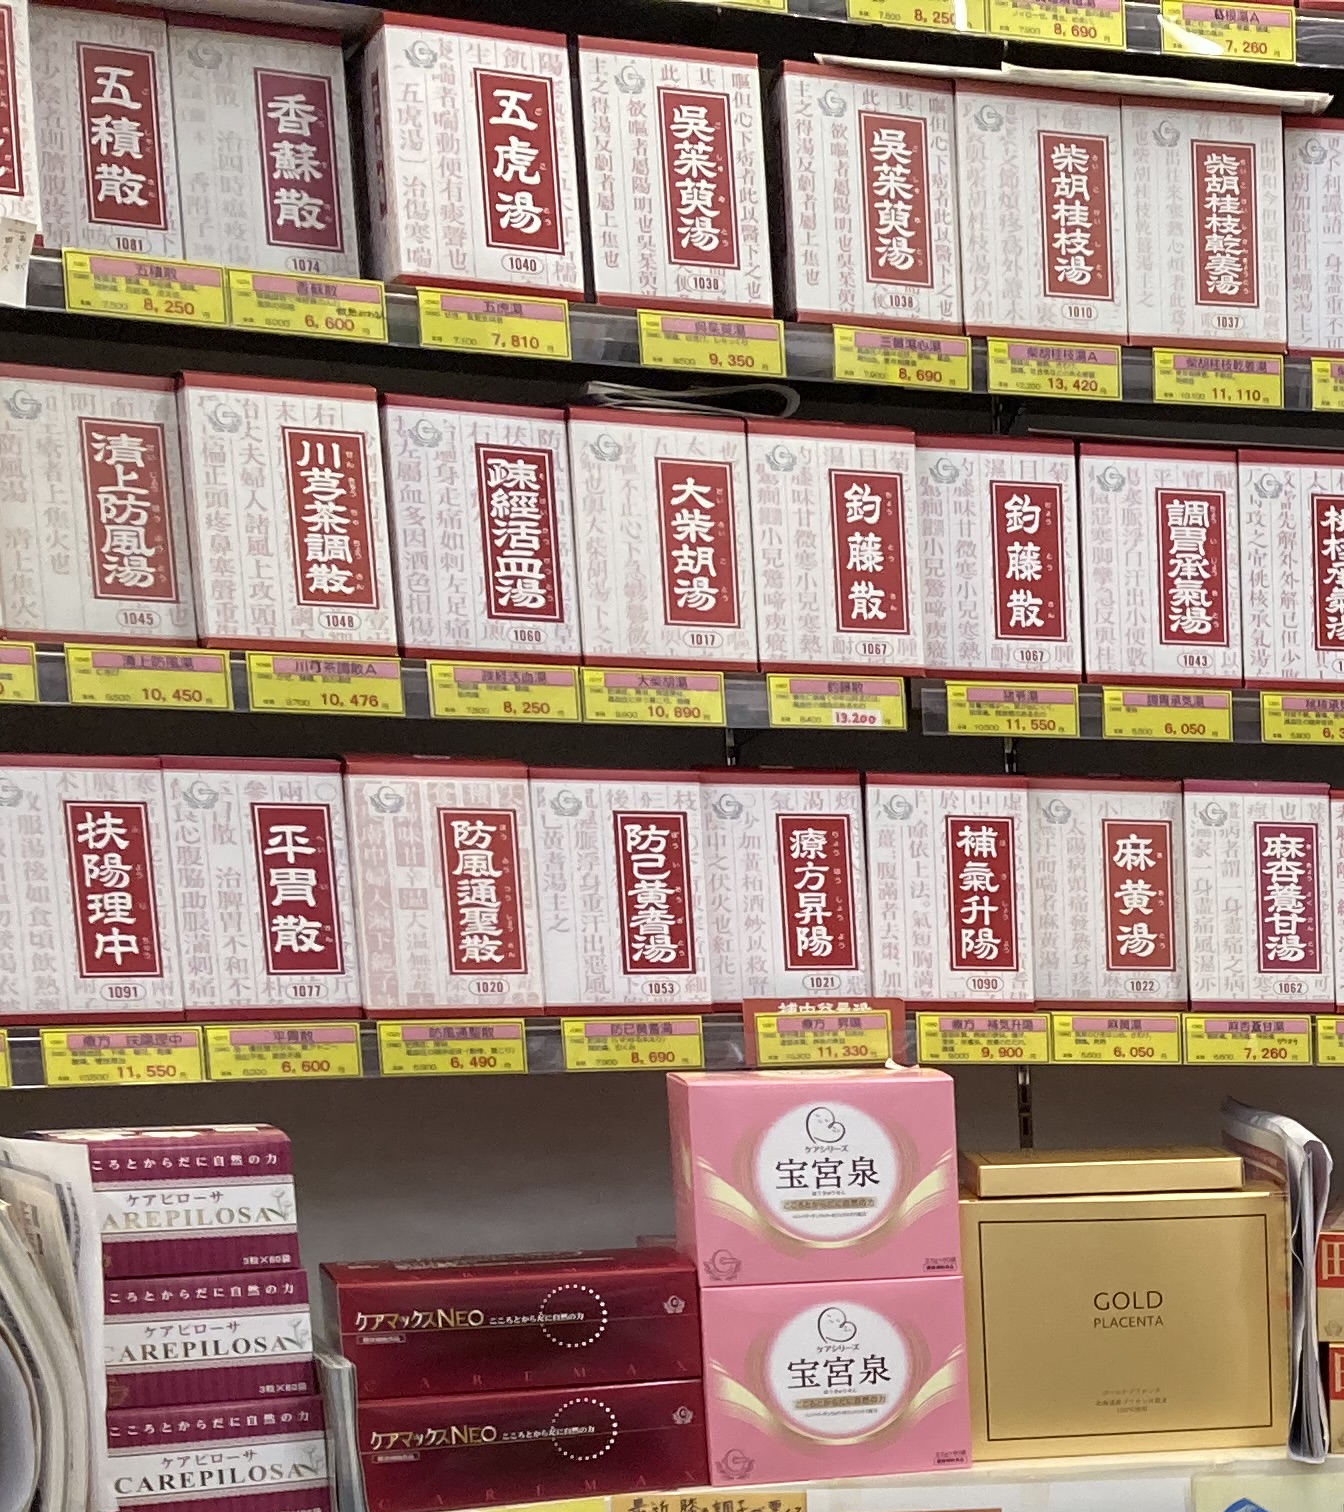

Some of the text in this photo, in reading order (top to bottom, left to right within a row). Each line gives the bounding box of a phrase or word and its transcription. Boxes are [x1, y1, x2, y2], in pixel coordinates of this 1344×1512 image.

[114, 238, 144, 251] 1081
[509, 256, 536, 272] 1040
[1216, 316, 1240, 329] 1037
[326, 614, 354, 628] 1048
[1184, 655, 1208, 668] 1043
[648, 982, 676, 995] 1053
[973, 978, 998, 990] 1090
[1278, 982, 1302, 994] 1062
[108, 985, 139, 999] 1091
[776, 1156, 880, 1190] 宝宮泉
[101, 1204, 270, 1232] AREPILOSA
[1094, 1290, 1164, 1311] GOLD
[1094, 1315, 1164, 1329] PLACENTA
[786, 1355, 892, 1390] 宝宮泉
[115, 1464, 300, 1494] CAREPILOSA
